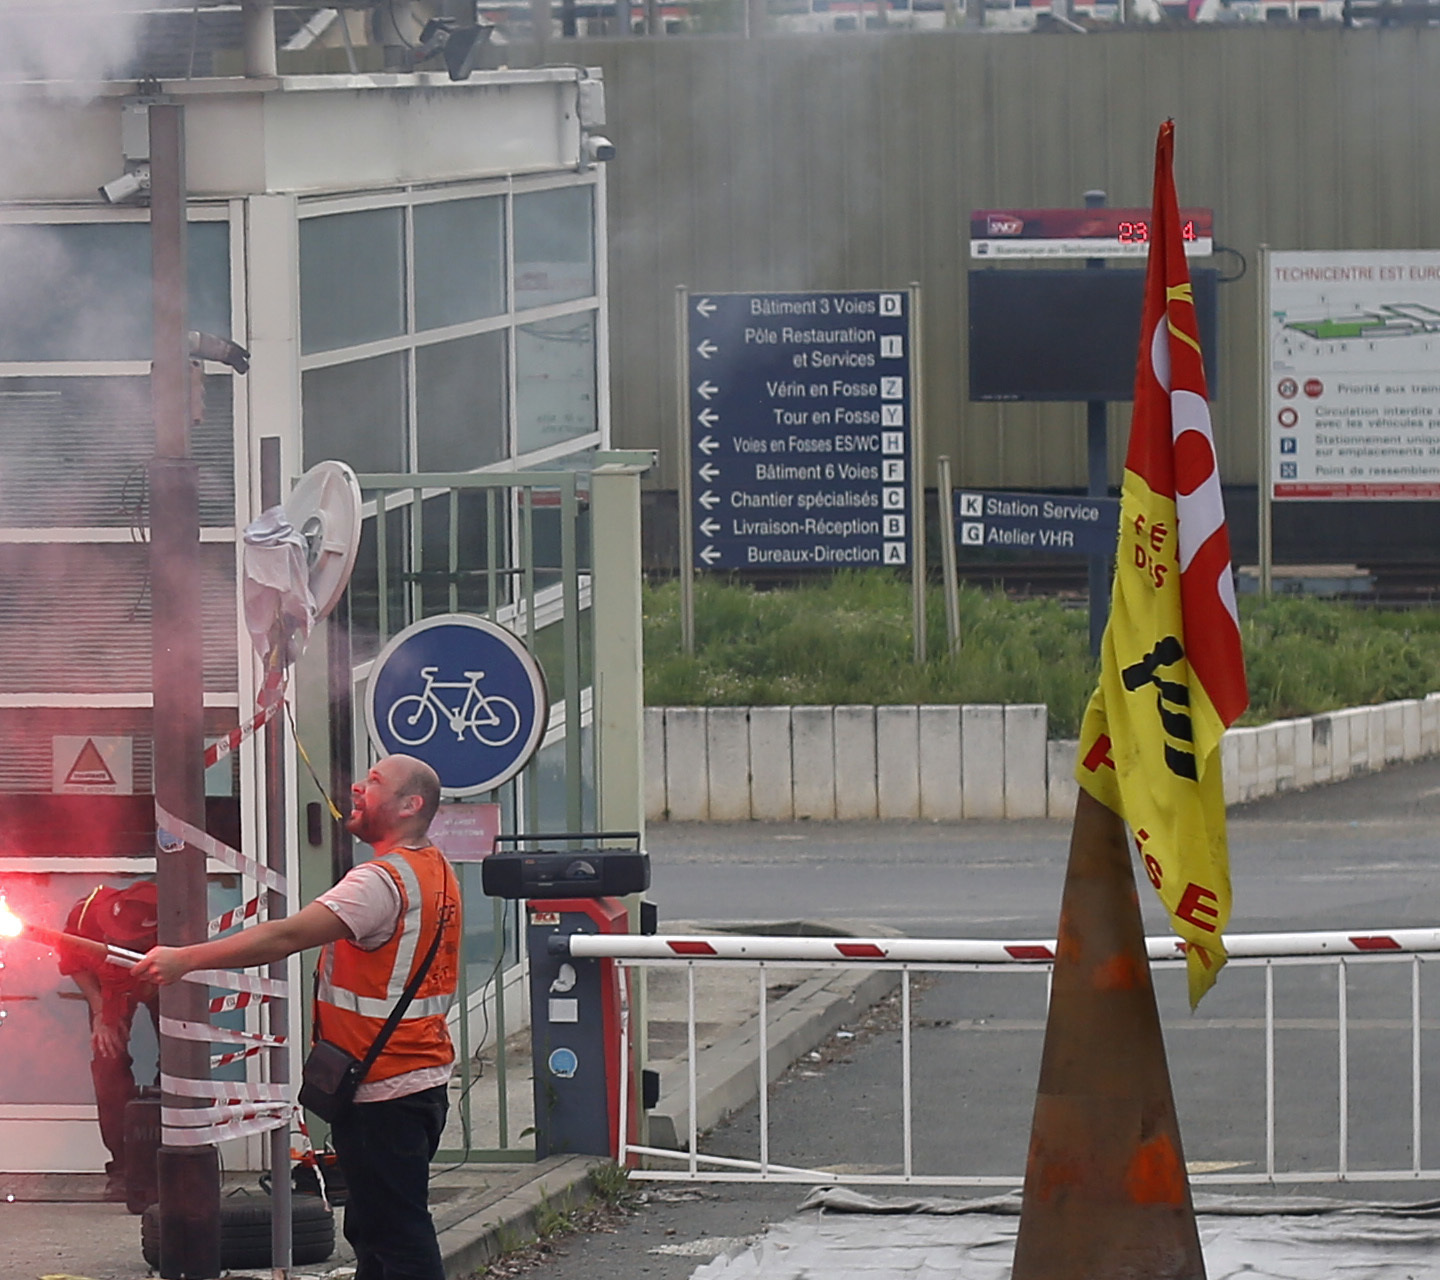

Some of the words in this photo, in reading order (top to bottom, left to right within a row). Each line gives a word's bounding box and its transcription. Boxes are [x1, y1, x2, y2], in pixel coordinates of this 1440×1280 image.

[1275, 267, 1373, 281] TECHNICENTRE
[1380, 266, 1403, 280] EST
[750, 299, 816, 316] Bâtiment
[820, 299, 830, 314] 3
[833, 298, 875, 313] Voies
[883, 297, 898, 313] D
[745, 328, 777, 344] Pôle
[782, 327, 875, 344] Restauration
[793, 353, 808, 368] et
[811, 351, 875, 368] Services
[767, 381, 805, 397] Vérin
[810, 384, 828, 397] en
[833, 381, 878, 397] Fosse
[886, 380, 897, 395] Z
[774, 409, 808, 424] Tour
[813, 412, 831, 425] en
[835, 408, 880, 424] Fosse
[887, 408, 898, 423] Y
[733, 437, 768, 452] Voies
[770, 440, 786, 452] en
[788, 436, 832, 452] Fosses
[888, 435, 899, 451] H
[756, 463, 821, 480] Bâtiment
[825, 464, 835, 479] 6
[838, 464, 878, 479] Voies
[888, 463, 898, 478] F
[731, 491, 793, 507] Chantier
[797, 491, 879, 512] spécialisés
[888, 490, 899, 506] C
[965, 496, 979, 514] K
[986, 498, 1039, 517] Station
[1043, 501, 1099, 521] Service
[733, 519, 879, 538] Livraison-Réception
[889, 518, 900, 533] B
[966, 527, 980, 543] G
[987, 527, 1036, 545] Atelier
[1039, 530, 1074, 547] VHR
[747, 546, 880, 563] Bureaux-Direction
[888, 546, 901, 561] A
